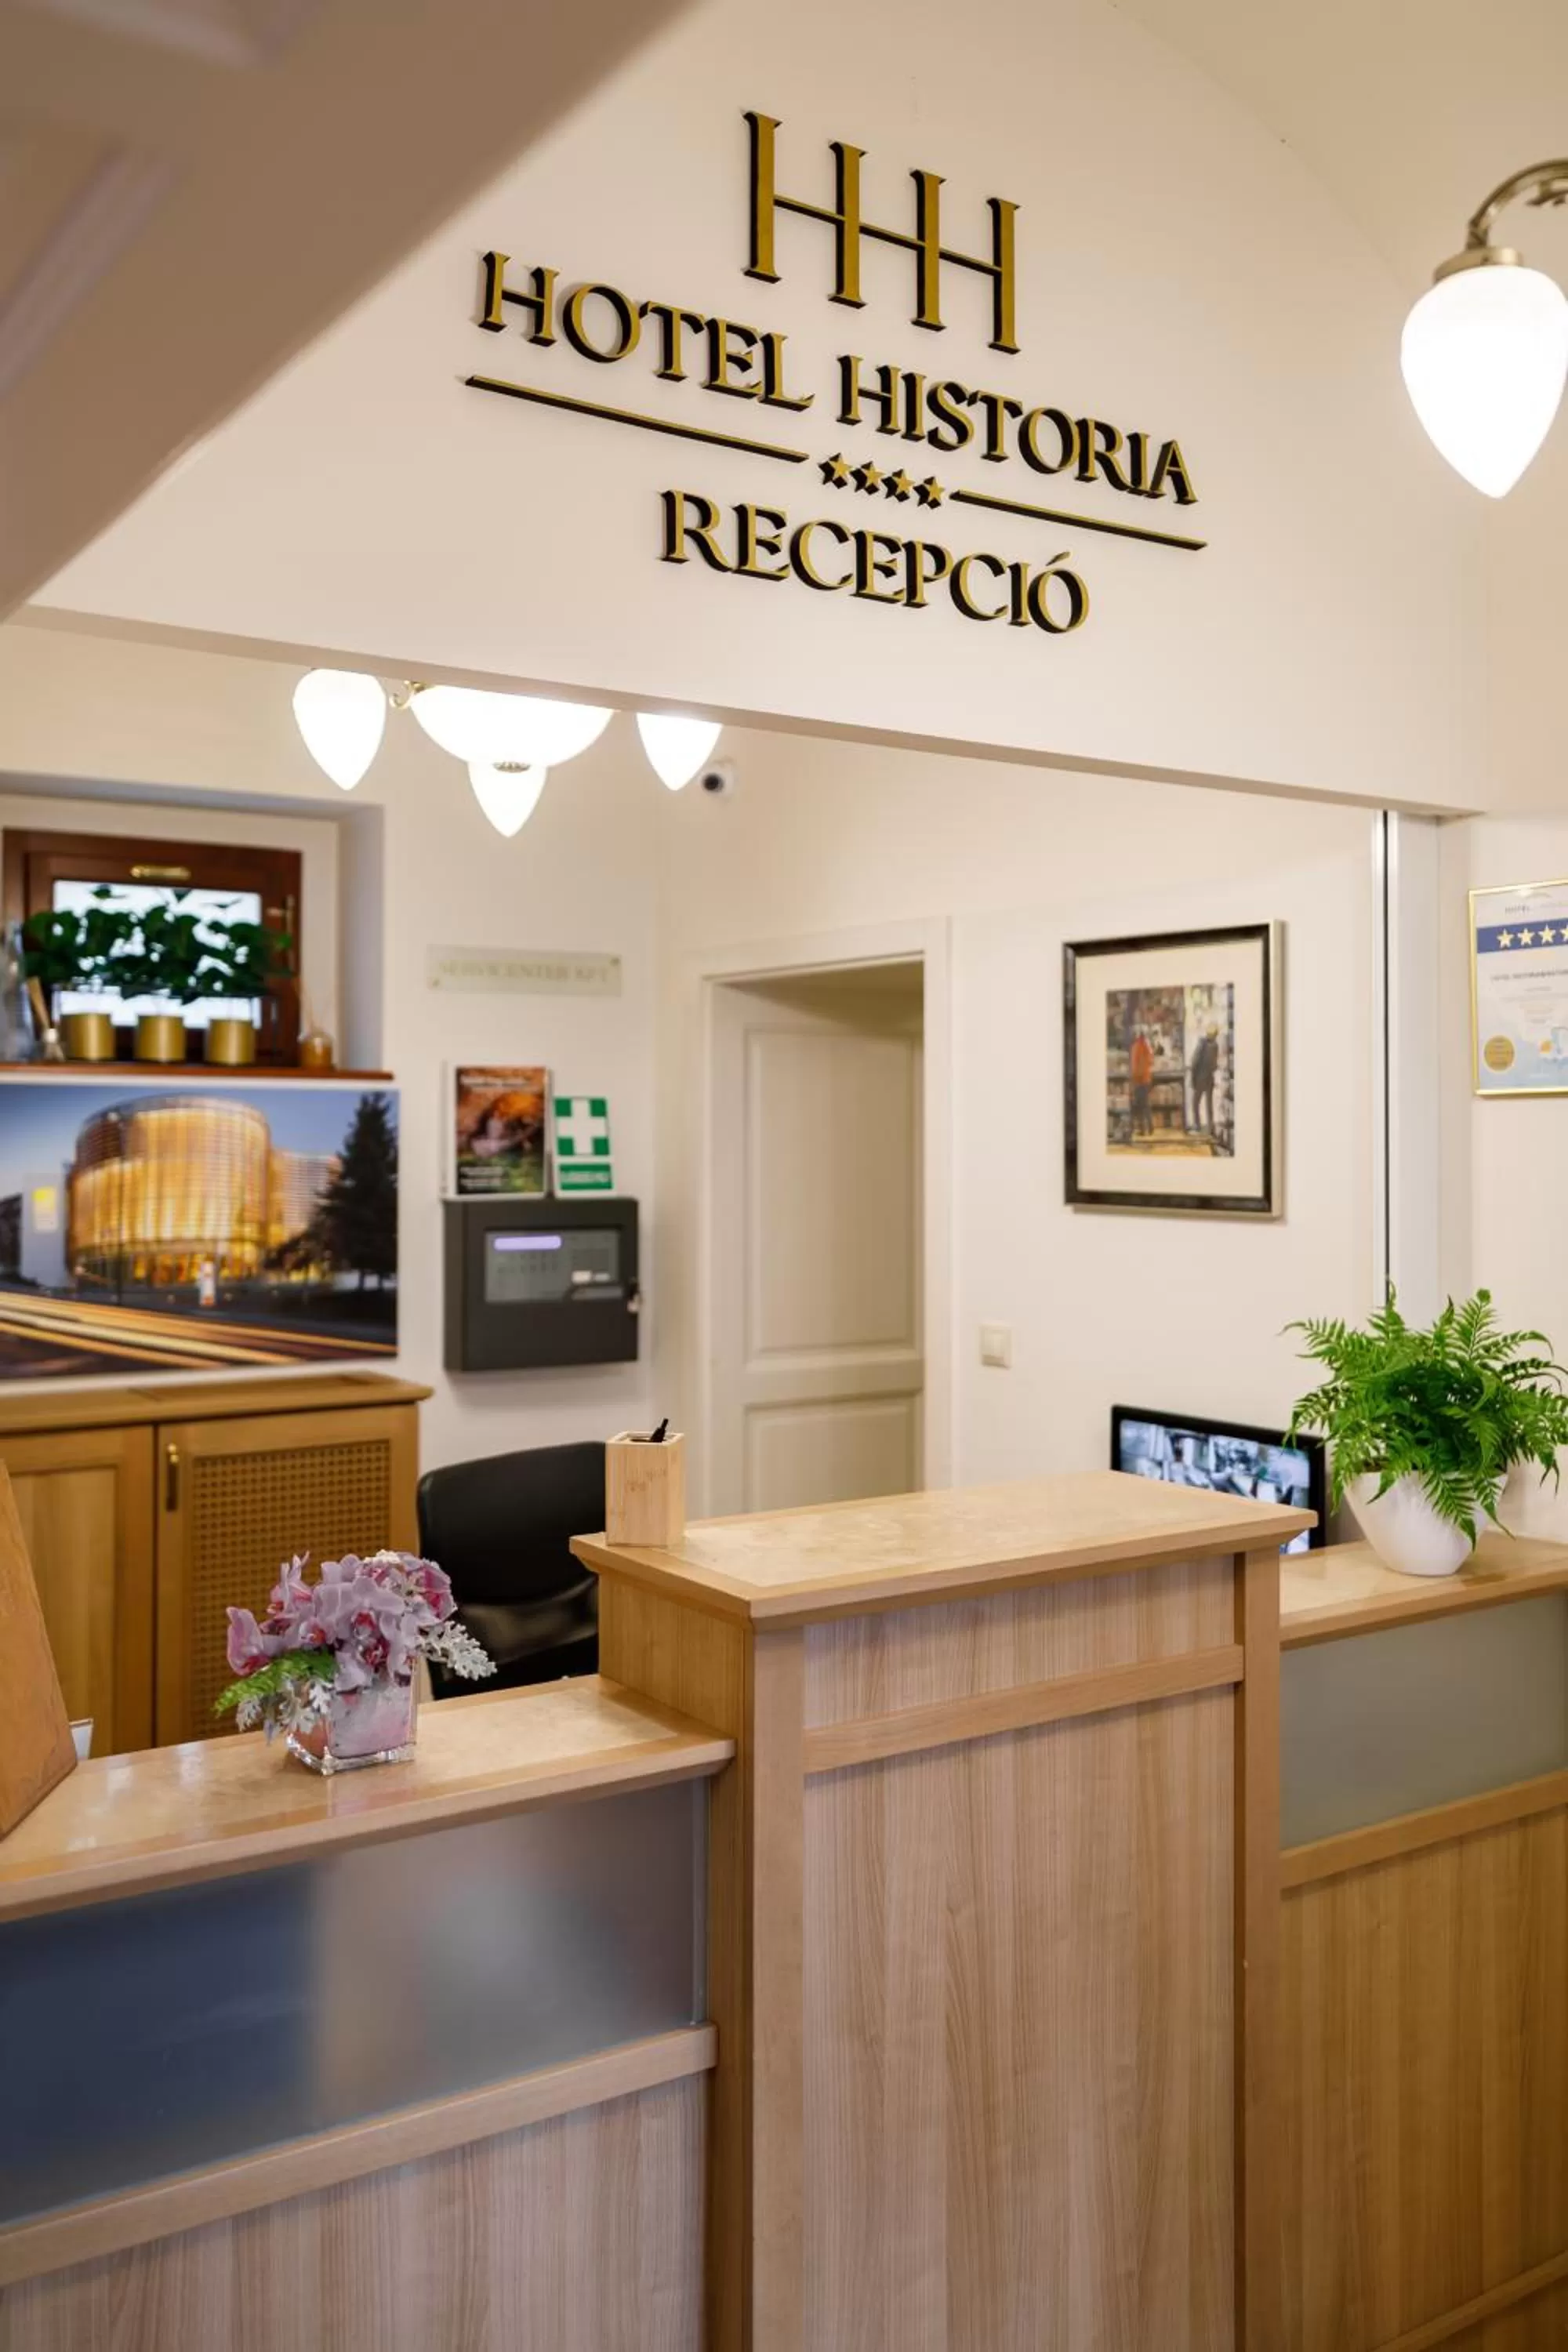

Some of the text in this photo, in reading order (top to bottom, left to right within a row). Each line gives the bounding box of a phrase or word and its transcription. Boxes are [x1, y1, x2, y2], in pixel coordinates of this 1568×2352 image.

[477, 250, 1201, 506] HOTEL HISTORIA
[659, 488, 1091, 637] RECEPCIÓ
